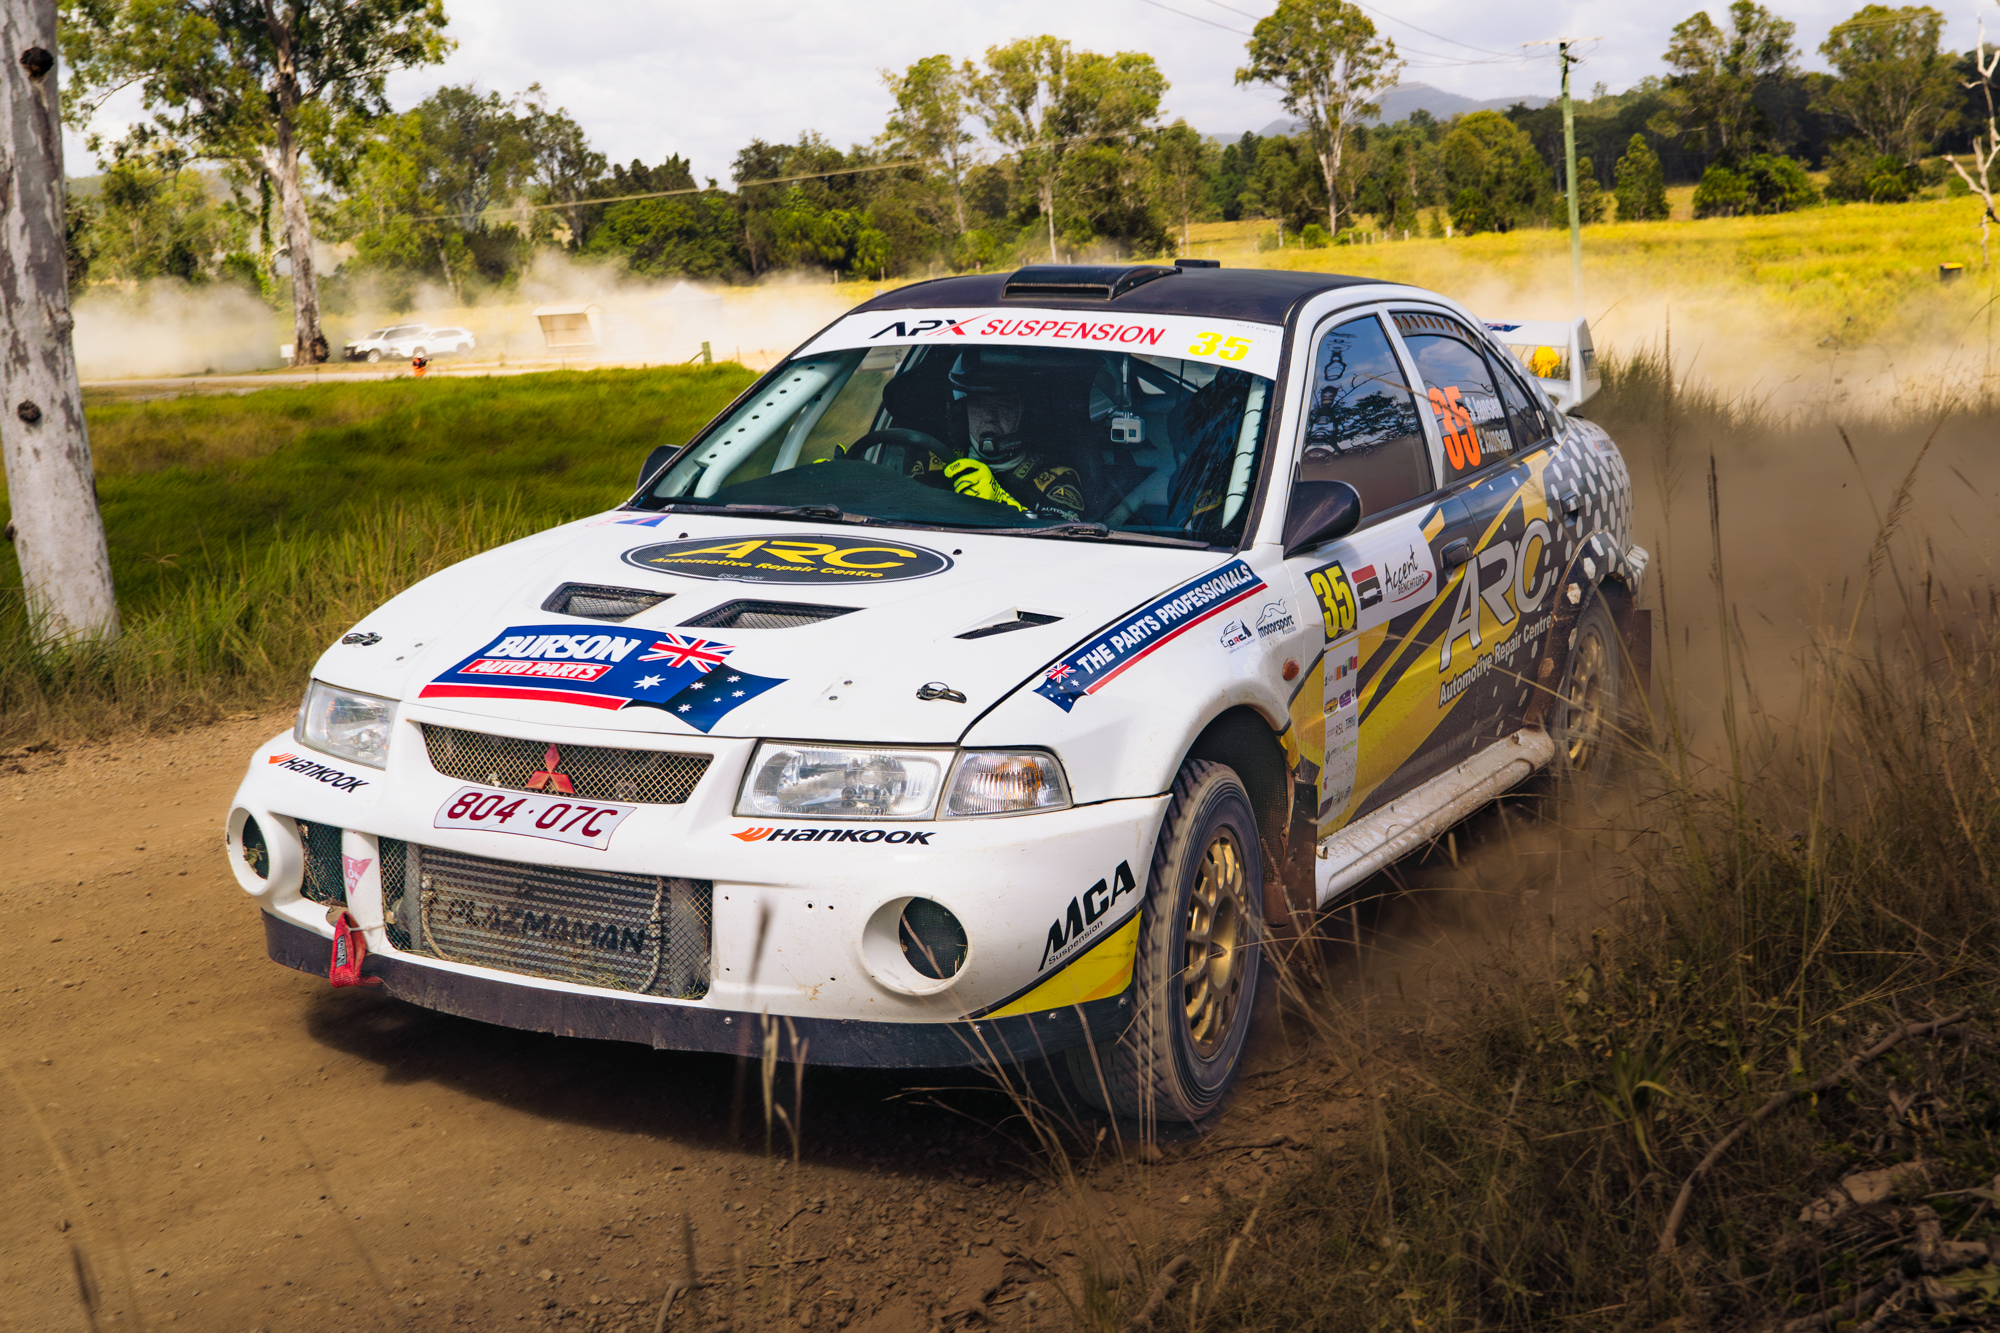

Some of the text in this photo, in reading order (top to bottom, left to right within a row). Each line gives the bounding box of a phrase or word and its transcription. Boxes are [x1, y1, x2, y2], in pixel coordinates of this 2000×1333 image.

[868, 317, 1253, 361] APX SUSPENSION 35
[1428, 386, 1481, 470] 35
[649, 557, 884, 578] Automotive Repair Centre
[664, 540, 918, 569] ARC
[1384, 544, 1419, 594] Accent
[1310, 565, 1355, 639] 35
[1397, 574, 1426, 595] BENCHTOPS
[1439, 519, 1552, 673] ARC
[1076, 563, 1253, 675] THE PARTS PROFESSIONALS
[469, 660, 599, 679] AUTO PARTS
[483, 634, 642, 663] BURSON
[1439, 614, 1553, 707] Automotive Repair Centre
[1038, 859, 1136, 973] MCA
[1048, 920, 1104, 965] Suspension
